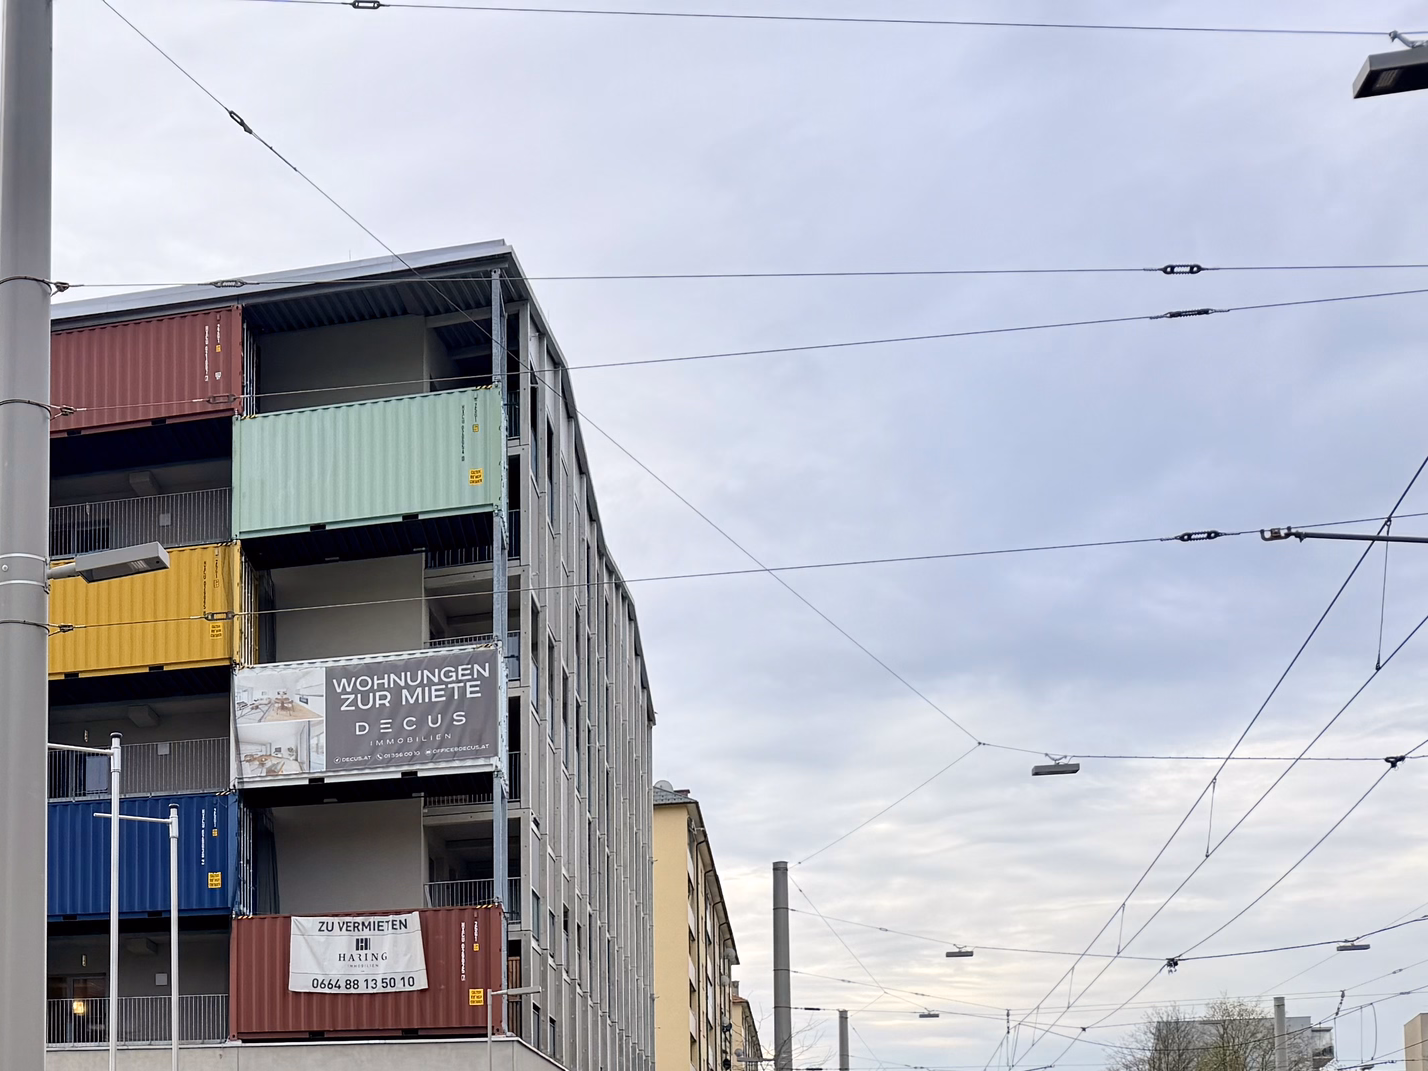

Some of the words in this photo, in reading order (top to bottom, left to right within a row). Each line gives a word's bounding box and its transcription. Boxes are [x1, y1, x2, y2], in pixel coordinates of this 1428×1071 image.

[333, 663, 490, 693] WOHNUNGEN
[340, 691, 392, 711] ZUR
[402, 681, 482, 706] MIETE
[355, 711, 467, 735] DECUS
[370, 733, 452, 746] IMMOBILIEN
[318, 921, 335, 932] ZU
[338, 919, 408, 932] VERMIETEN
[338, 952, 388, 962] HARING
[312, 978, 341, 990] 0664
[345, 979, 360, 990] 88
[364, 978, 378, 989] 13
[381, 977, 396, 988] 50
[400, 976, 415, 988] 10
